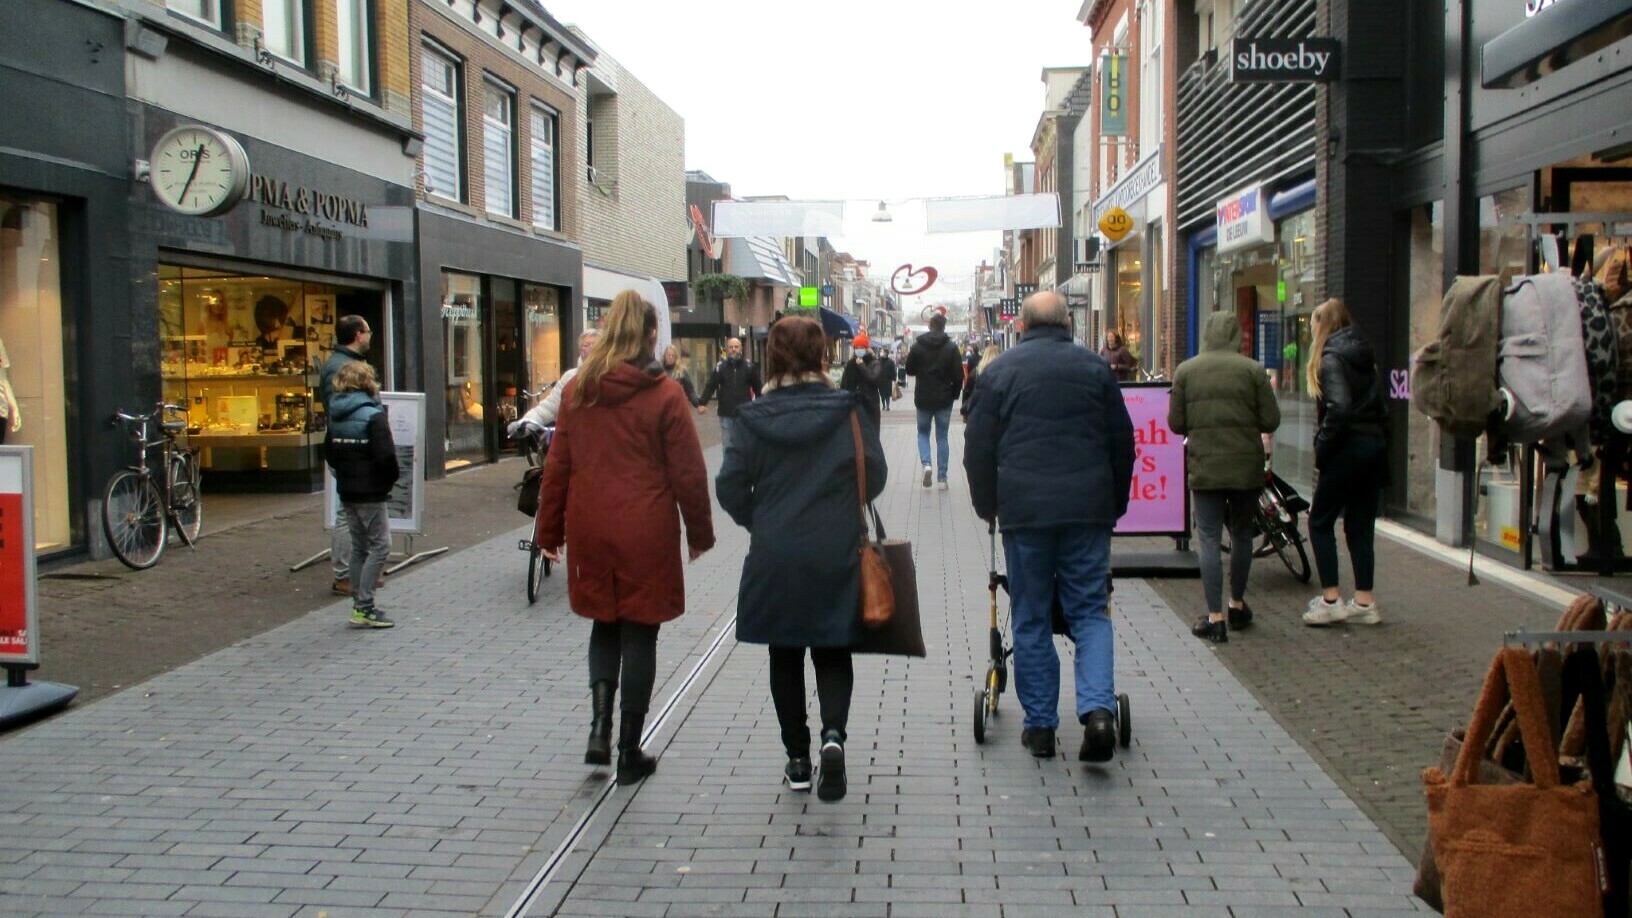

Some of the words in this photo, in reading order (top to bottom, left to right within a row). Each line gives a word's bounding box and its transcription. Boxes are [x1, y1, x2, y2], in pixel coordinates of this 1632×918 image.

[1237, 42, 1330, 75] shoeby
[180, 149, 211, 160] ORS
[249, 173, 294, 211] PMA
[295, 185, 310, 216] &
[311, 189, 369, 230] POPMA
[1390, 369, 1411, 400] sa
[1134, 418, 1169, 445] ah
[1131, 475, 1168, 500] le!
